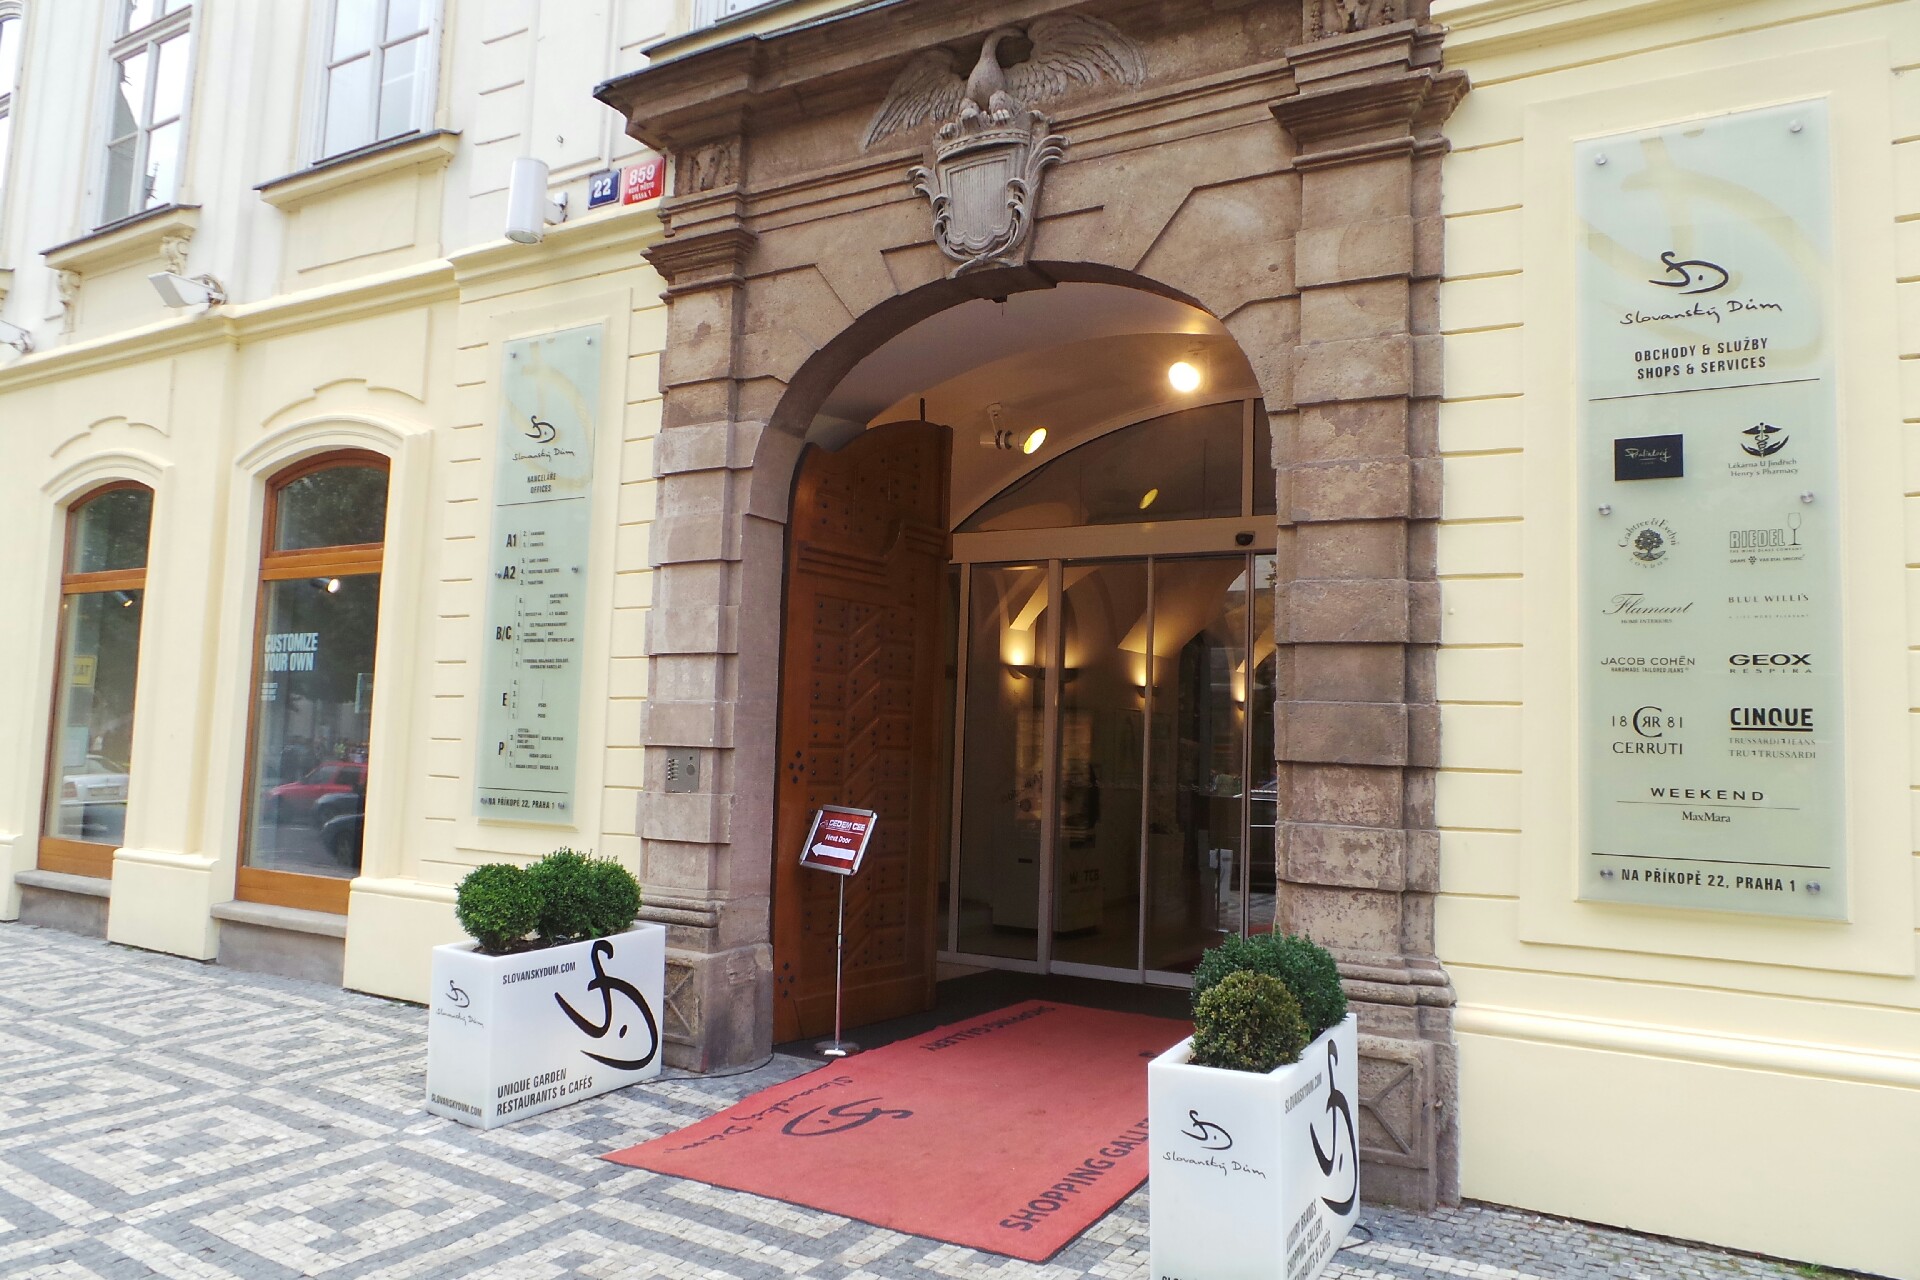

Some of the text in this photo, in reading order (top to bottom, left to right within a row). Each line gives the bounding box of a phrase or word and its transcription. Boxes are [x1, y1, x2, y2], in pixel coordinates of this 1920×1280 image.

[630, 164, 655, 186] 859
[593, 178, 612, 198] 22
[1634, 336, 1768, 363] OBCHODY & SLUŽBY
[1637, 356, 1766, 380] SHOPS & SERVICES
[530, 484, 552, 494] OFFICES
[506, 533, 517, 548] A1
[1729, 529, 1786, 549] RIEDEL
[502, 566, 516, 580] A2
[265, 632, 319, 652] CUSTOMIZE
[496, 626, 512, 642] B/C
[264, 652, 314, 672] YOUR OWN
[1600, 656, 1646, 666] JACOB
[1729, 653, 1812, 666] GEOX
[502, 692, 508, 707] E
[1730, 707, 1814, 727] CINQUE
[498, 741, 505, 756] P
[1612, 741, 1683, 755] CERRUTI
[1729, 737, 1780, 745] TRUSSARDI
[1728, 749, 1816, 759] TRU TRUSSARDI
[1651, 787, 1764, 801] WEEKEND
[532, 800, 550, 809] PRAHA
[1682, 811, 1731, 823] MaxMara
[825, 833, 852, 844] Next Door
[1621, 867, 1796, 892] NA PŘÍKOPĚ 22, PRAHA 1
[502, 961, 576, 985] SLOVANSKYDUM.COM
[497, 1068, 567, 1099] UNIQUE GARDEN
[496, 1076, 593, 1117] RESTAURANTS & CAFÉS
[431, 1092, 482, 1118] SLOVANSKYDUM.COM
[1000, 1158, 1116, 1232] SHOPPING
